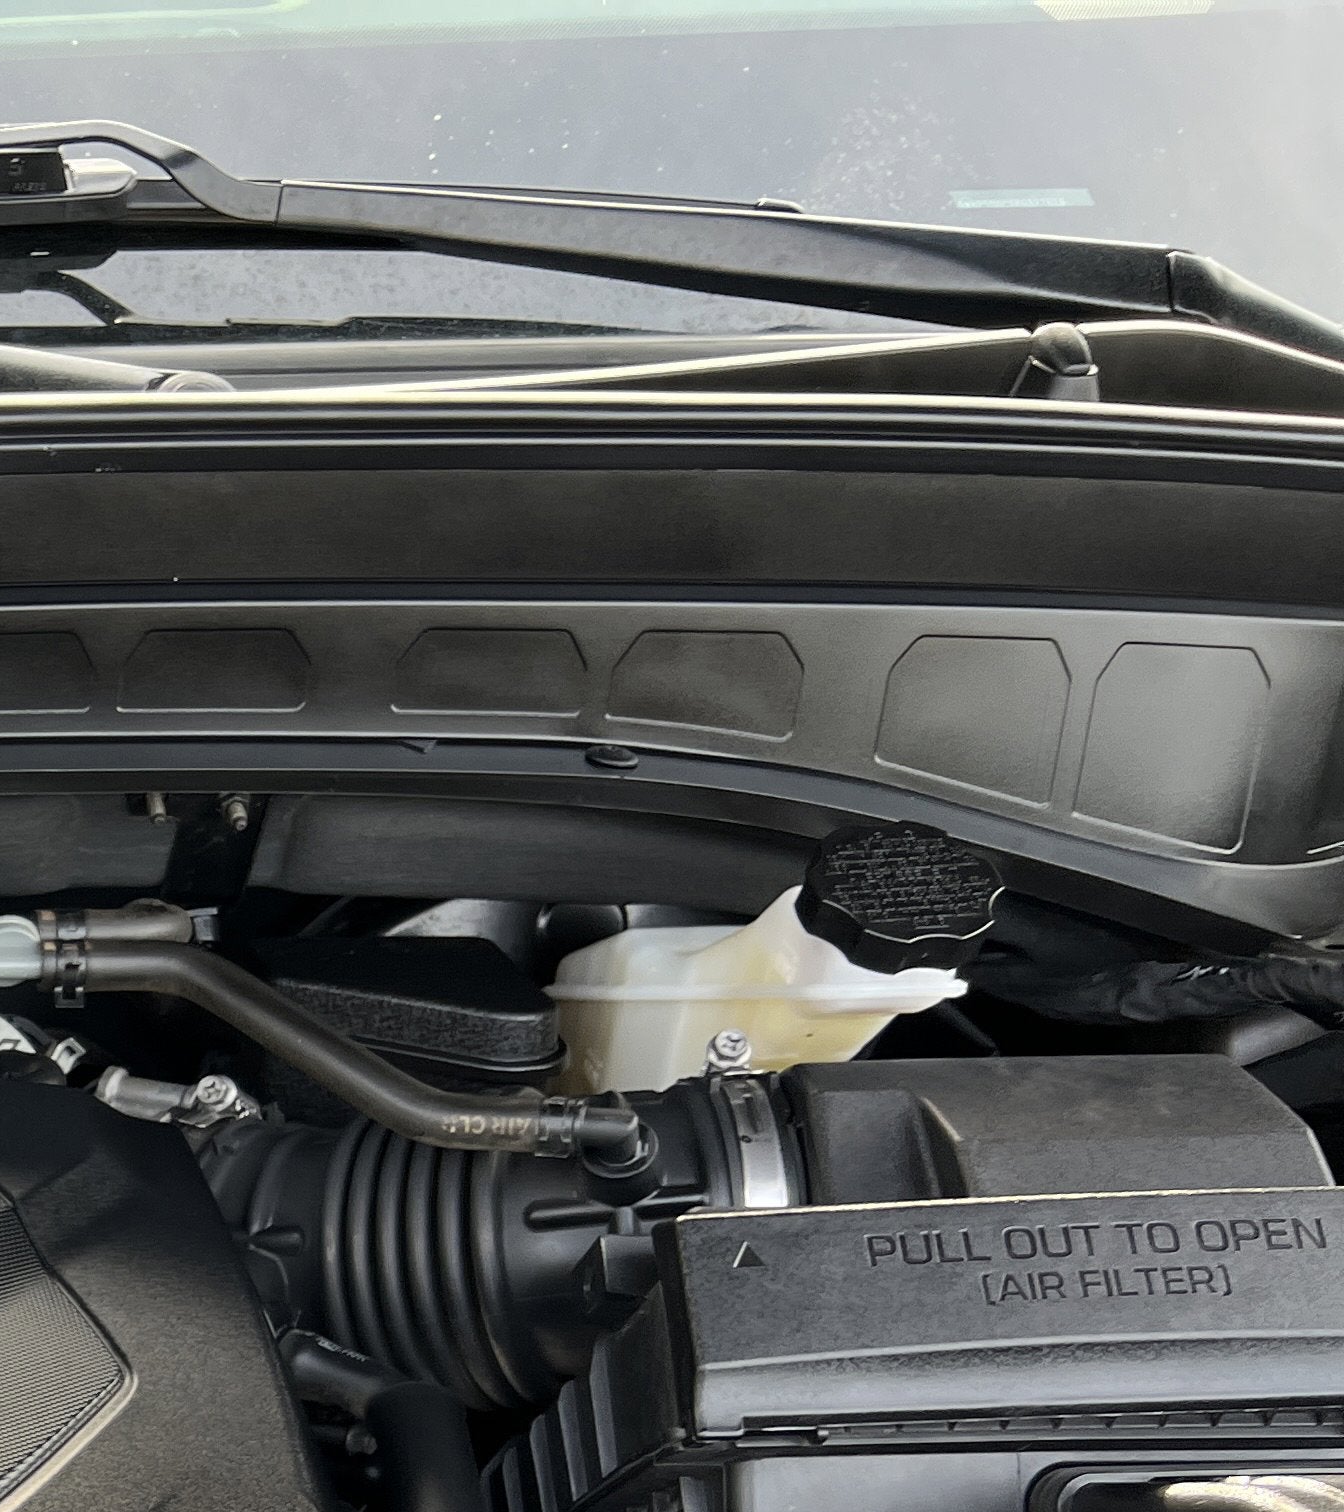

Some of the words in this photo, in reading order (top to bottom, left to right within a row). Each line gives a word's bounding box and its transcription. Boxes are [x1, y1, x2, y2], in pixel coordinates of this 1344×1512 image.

[864, 1228, 991, 1267] PULL
[1003, 1223, 1100, 1260] OUT
[1114, 1220, 1180, 1255] TO
[1195, 1217, 1328, 1252] OPEN
